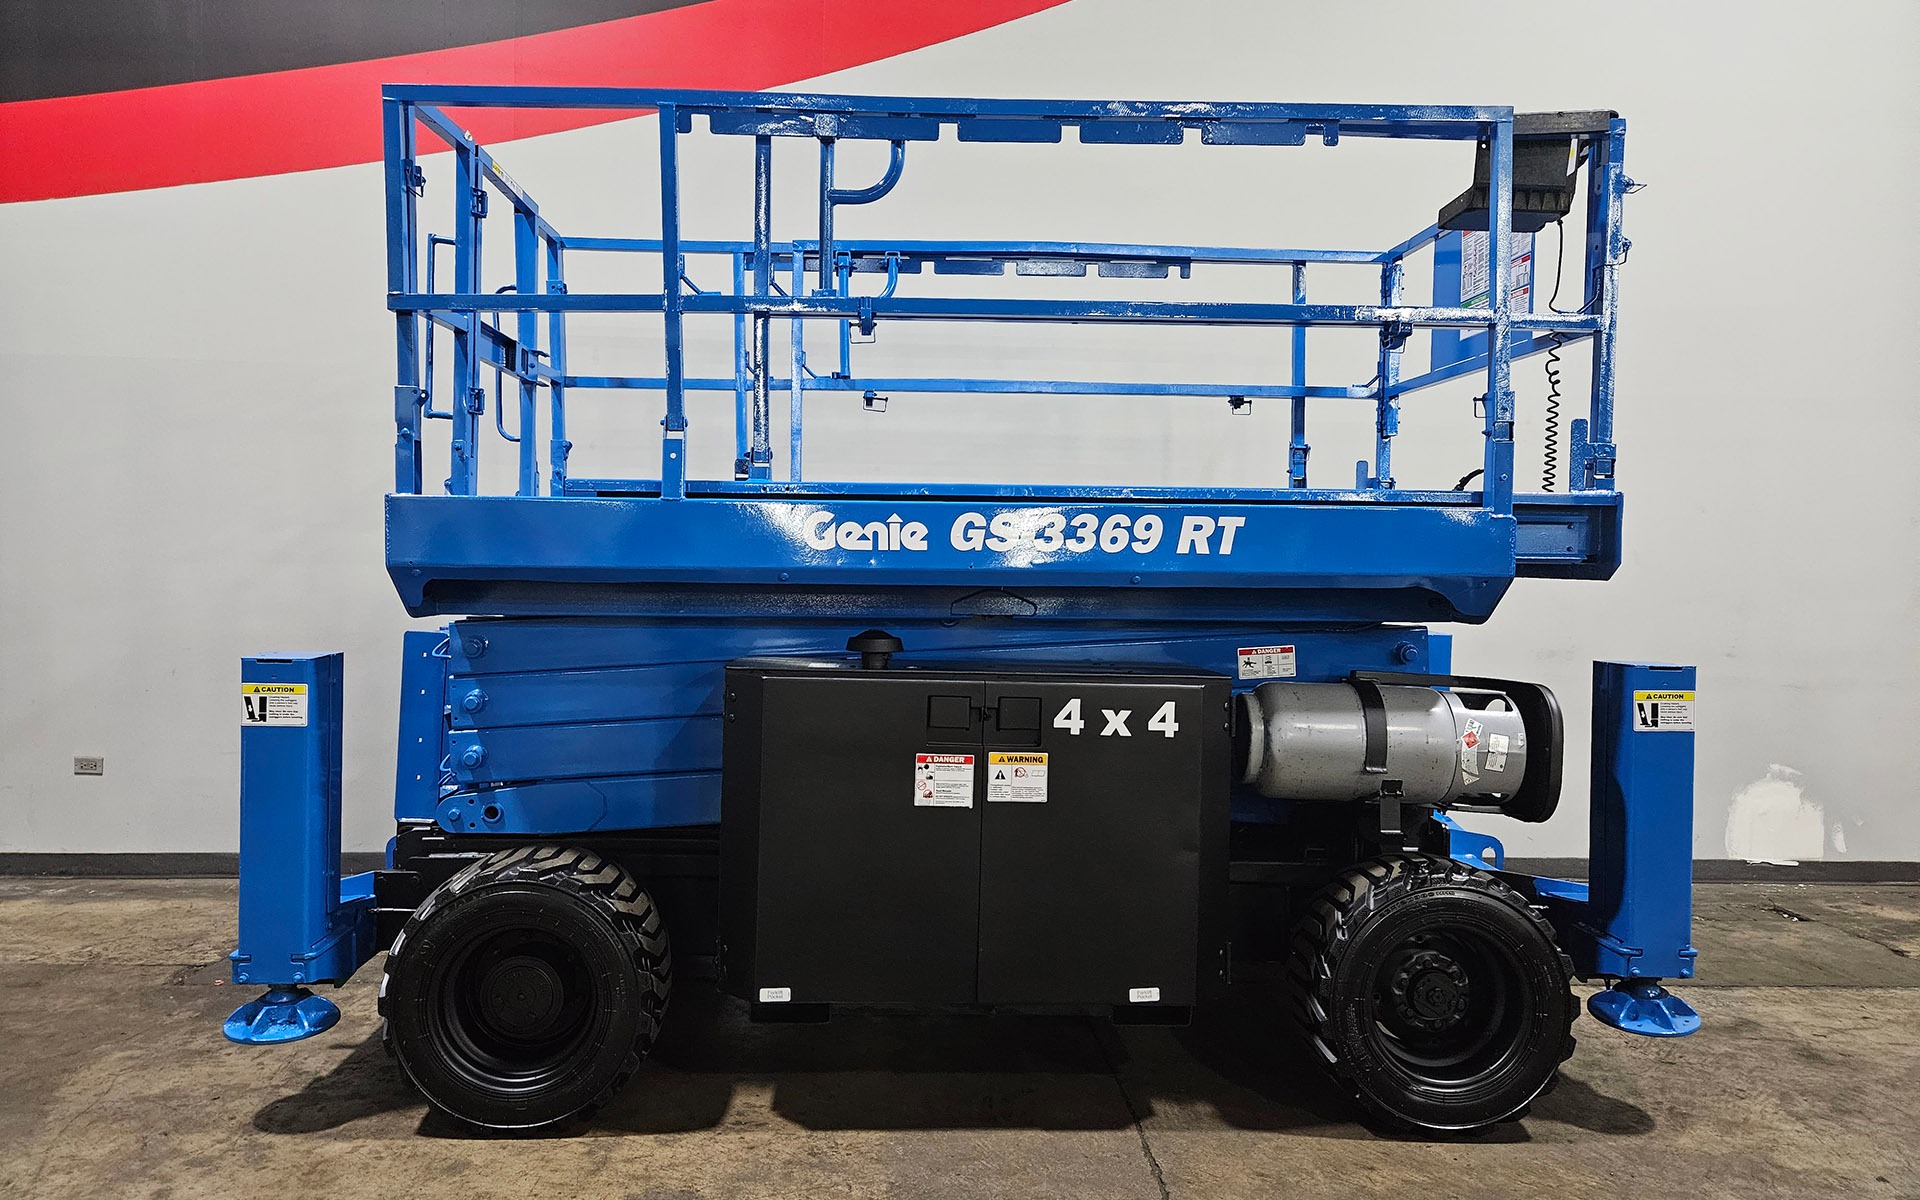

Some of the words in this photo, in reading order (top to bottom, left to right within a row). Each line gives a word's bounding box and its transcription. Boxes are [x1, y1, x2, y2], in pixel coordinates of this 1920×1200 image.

[805, 512, 928, 551] Genie
[1176, 515, 1246, 555] RT
[1053, 698, 1085, 735] 4
[1099, 709, 1133, 737] x
[1147, 701, 1179, 738] 4
[933, 756, 965, 764] DANGER
[1006, 755, 1044, 764] WARNING
